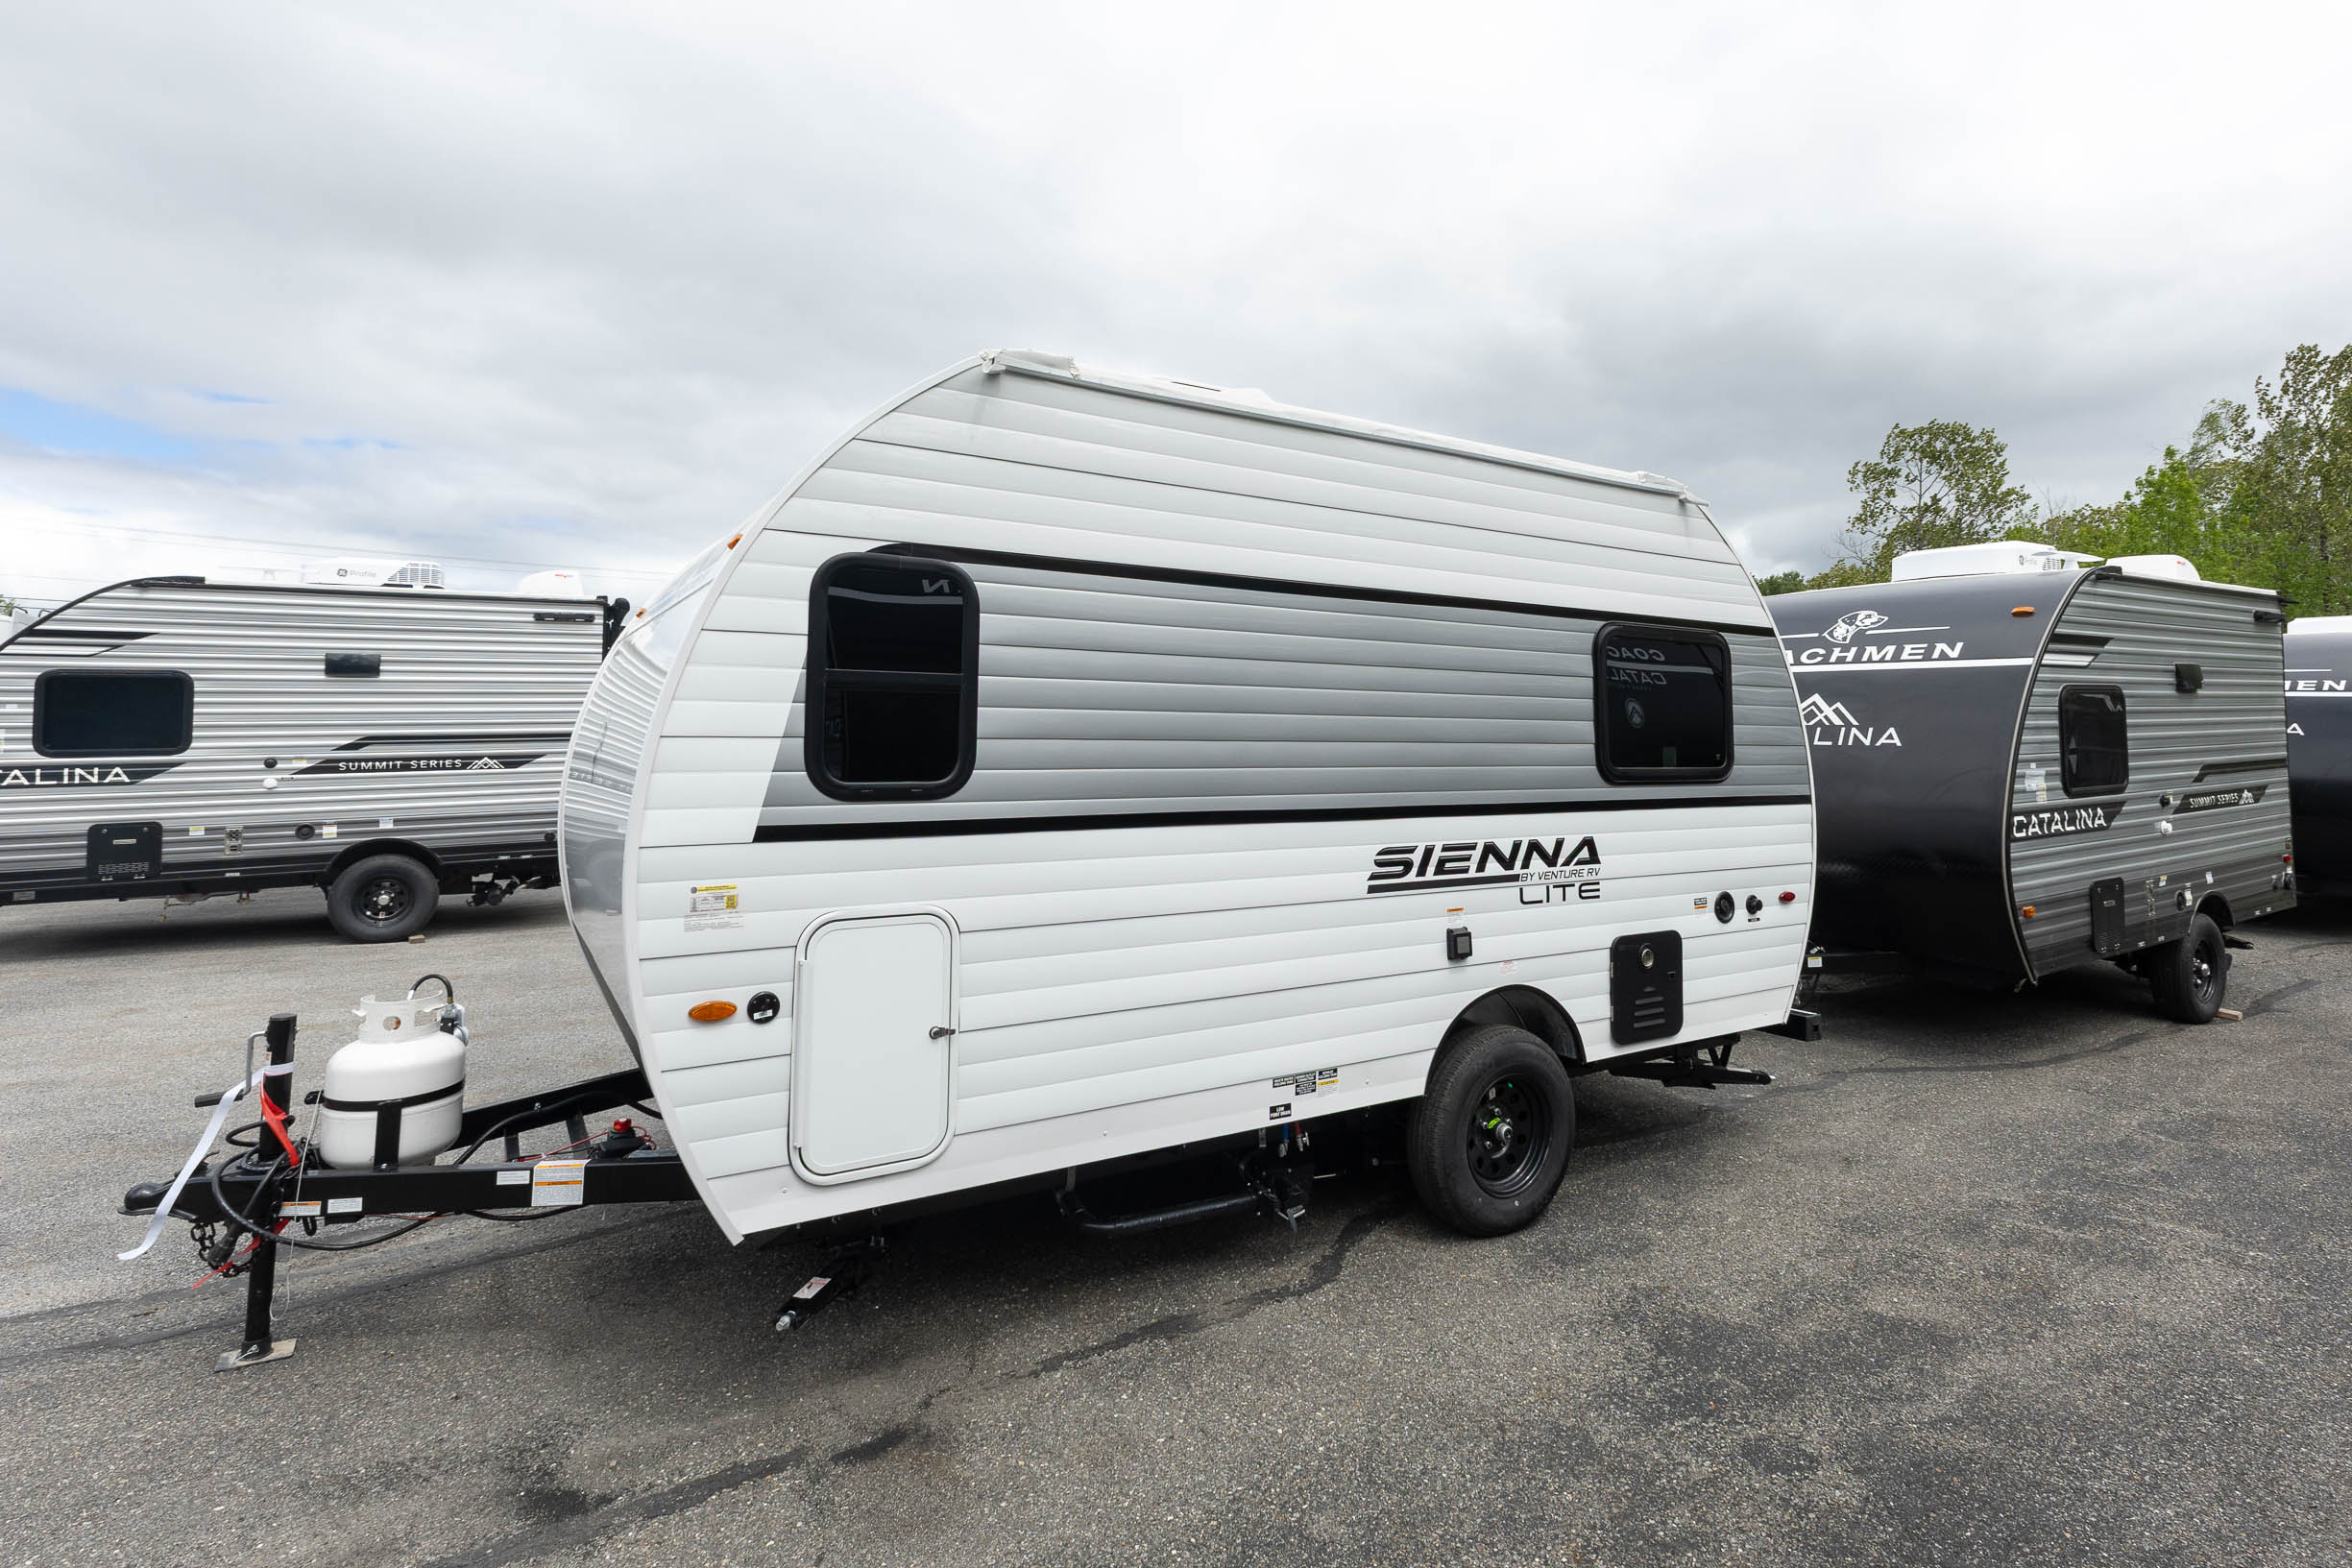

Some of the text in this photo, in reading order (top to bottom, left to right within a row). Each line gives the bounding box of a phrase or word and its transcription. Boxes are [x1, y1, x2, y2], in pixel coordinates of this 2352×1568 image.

[338, 759, 463, 771] SUMMIT SERIES
[0, 766, 131, 786] ALINA
[2190, 792, 2240, 808] SUMMIT SERIES
[2013, 807, 2107, 837] CATALINA
[1367, 835, 1602, 882] SIENNA
[1520, 867, 1601, 882] BY VENTURE RV
[1519, 881, 1601, 905] LITE
